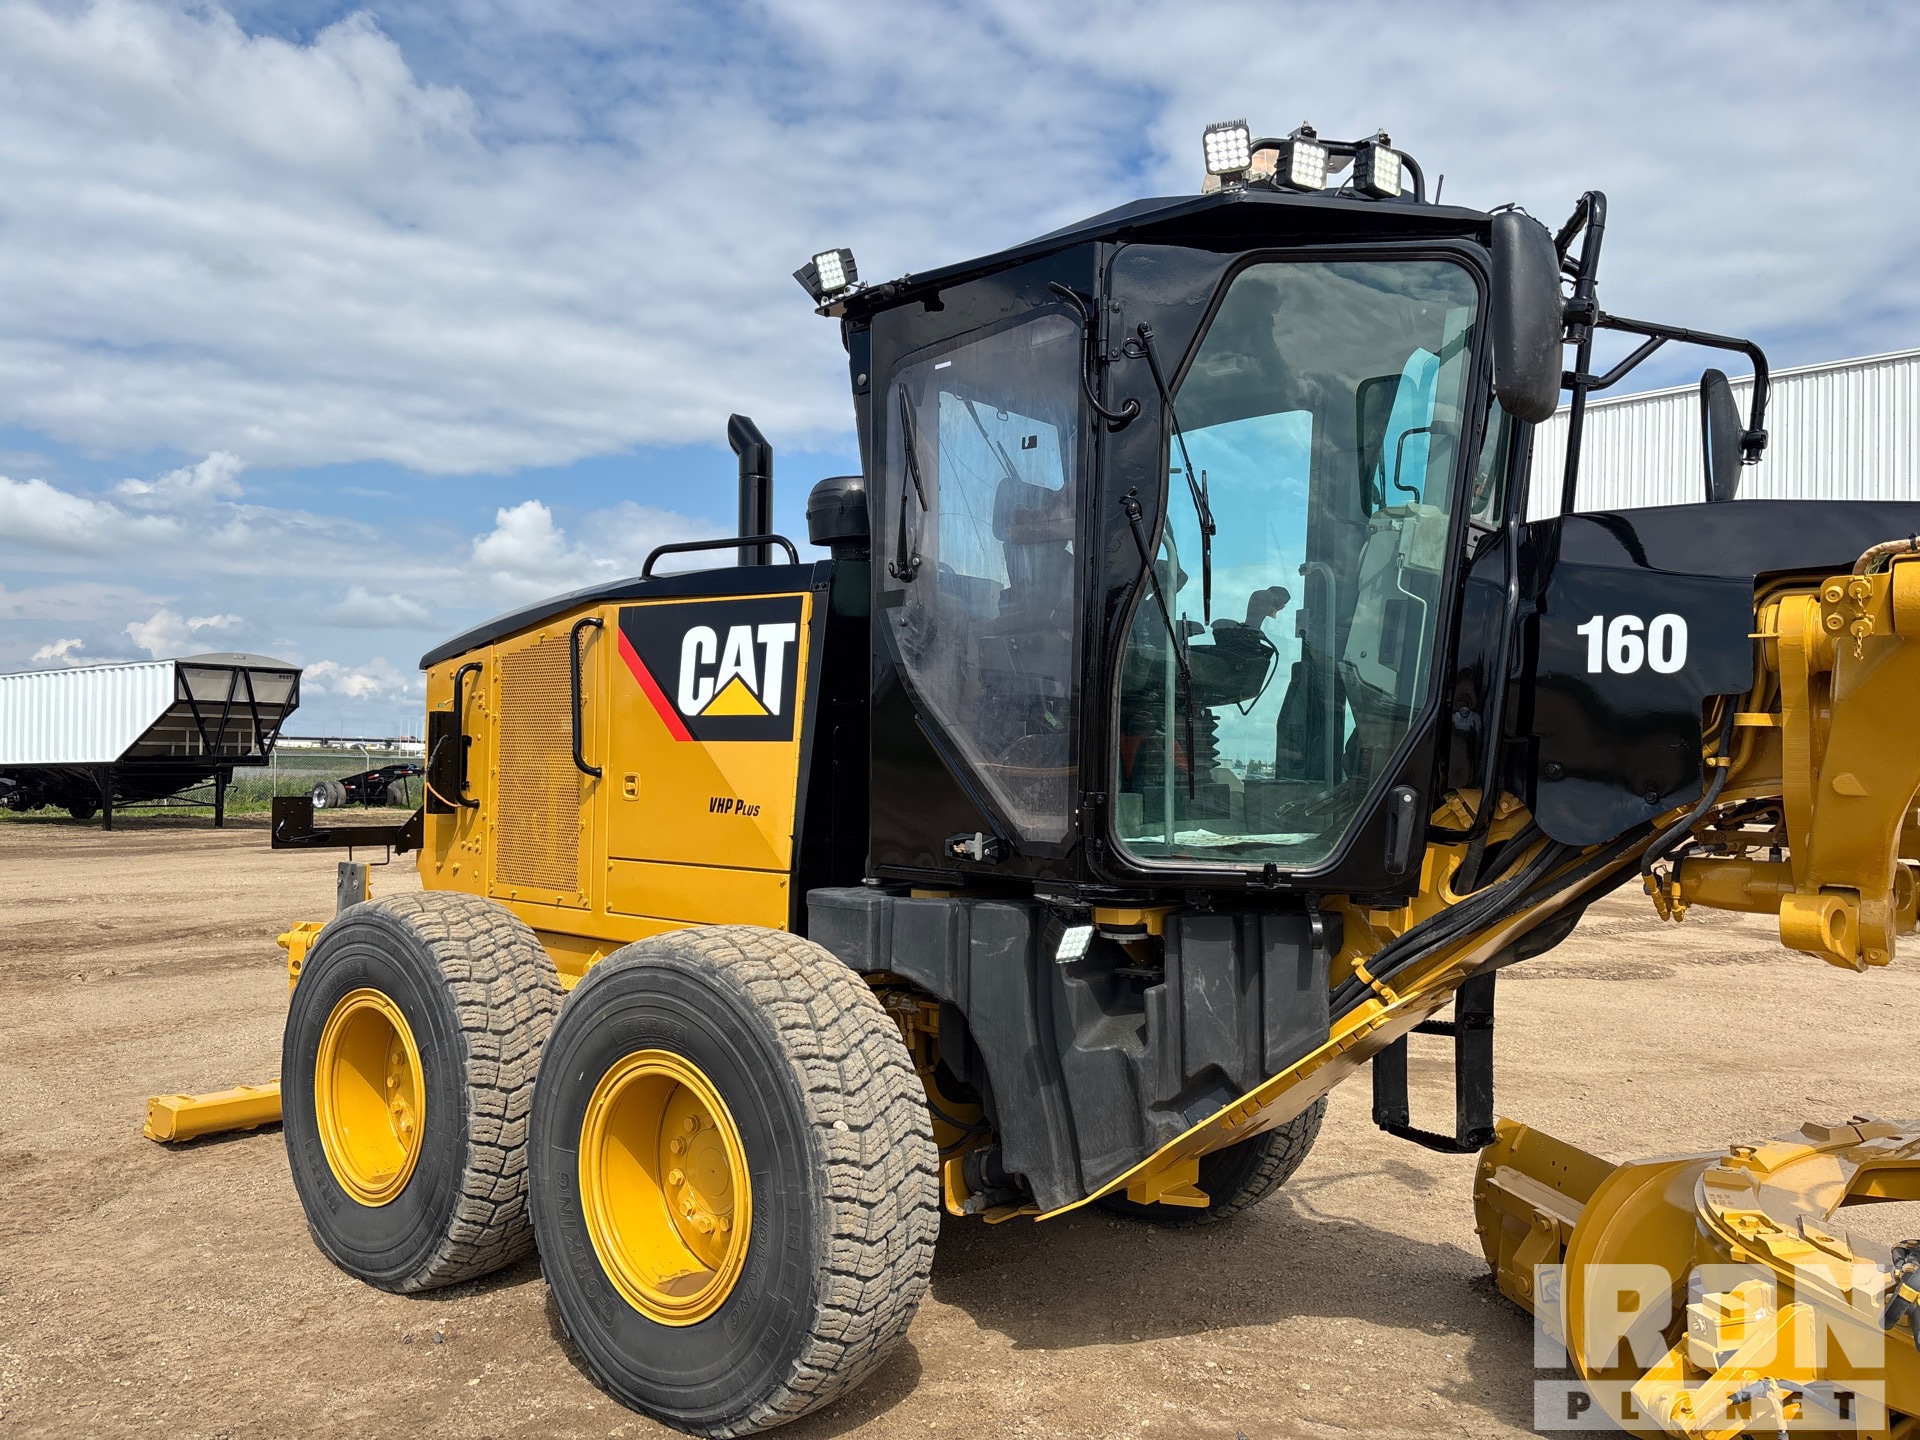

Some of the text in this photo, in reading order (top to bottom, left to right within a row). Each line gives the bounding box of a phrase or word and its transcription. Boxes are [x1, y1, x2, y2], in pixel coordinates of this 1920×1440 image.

[677, 622, 796, 716] CAT
[1576, 613, 1688, 674] 160
[709, 796, 733, 814] VHP
[616, 1017, 683, 1041] 17.5R25
[557, 1171, 621, 1329] TECHKING
[730, 1185, 768, 1330] SNOWKING
